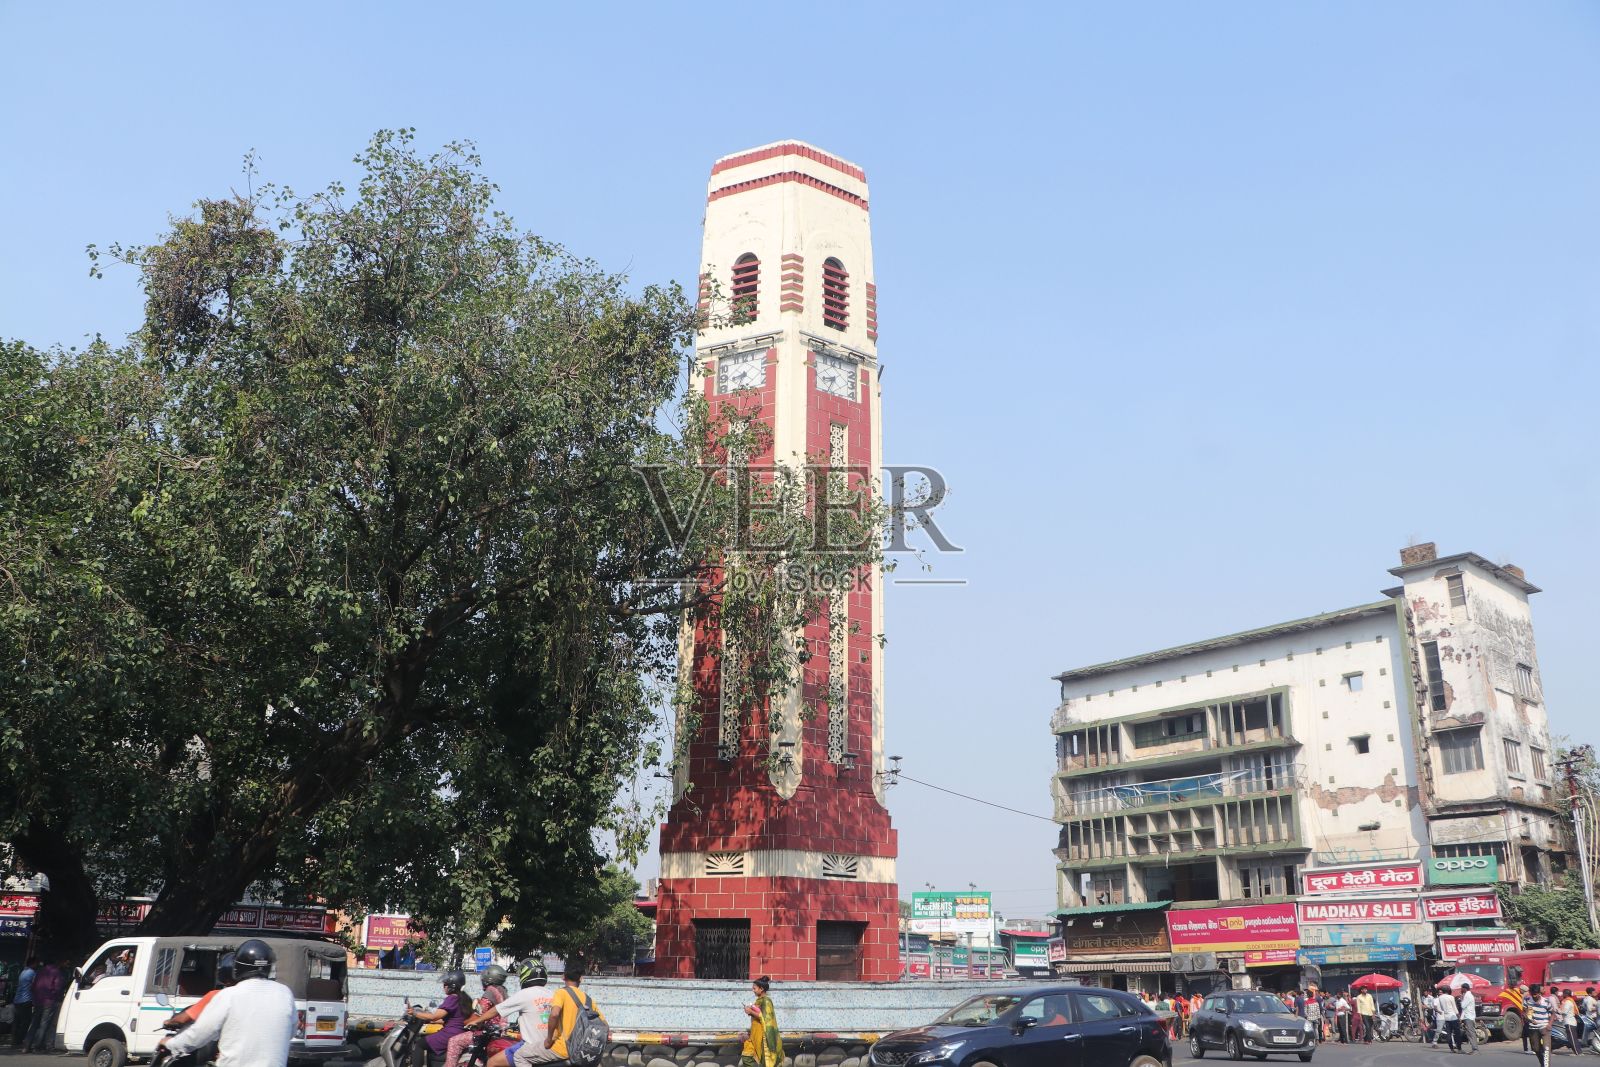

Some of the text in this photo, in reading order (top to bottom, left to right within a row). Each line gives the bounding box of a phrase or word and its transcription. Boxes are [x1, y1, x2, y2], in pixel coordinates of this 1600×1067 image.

[720, 364, 729, 374] 10
[720, 374, 729, 384] 9
[1435, 859, 1490, 872] oppo
[1307, 903, 1413, 918] MADHAV SALE
[239, 911, 257, 922] SHOP
[1244, 915, 1295, 928] punjab national bank
[1230, 919, 1243, 928] pnb
[373, 926, 391, 936] PNB
[1446, 942, 1515, 953] WE COMMUNICATION
